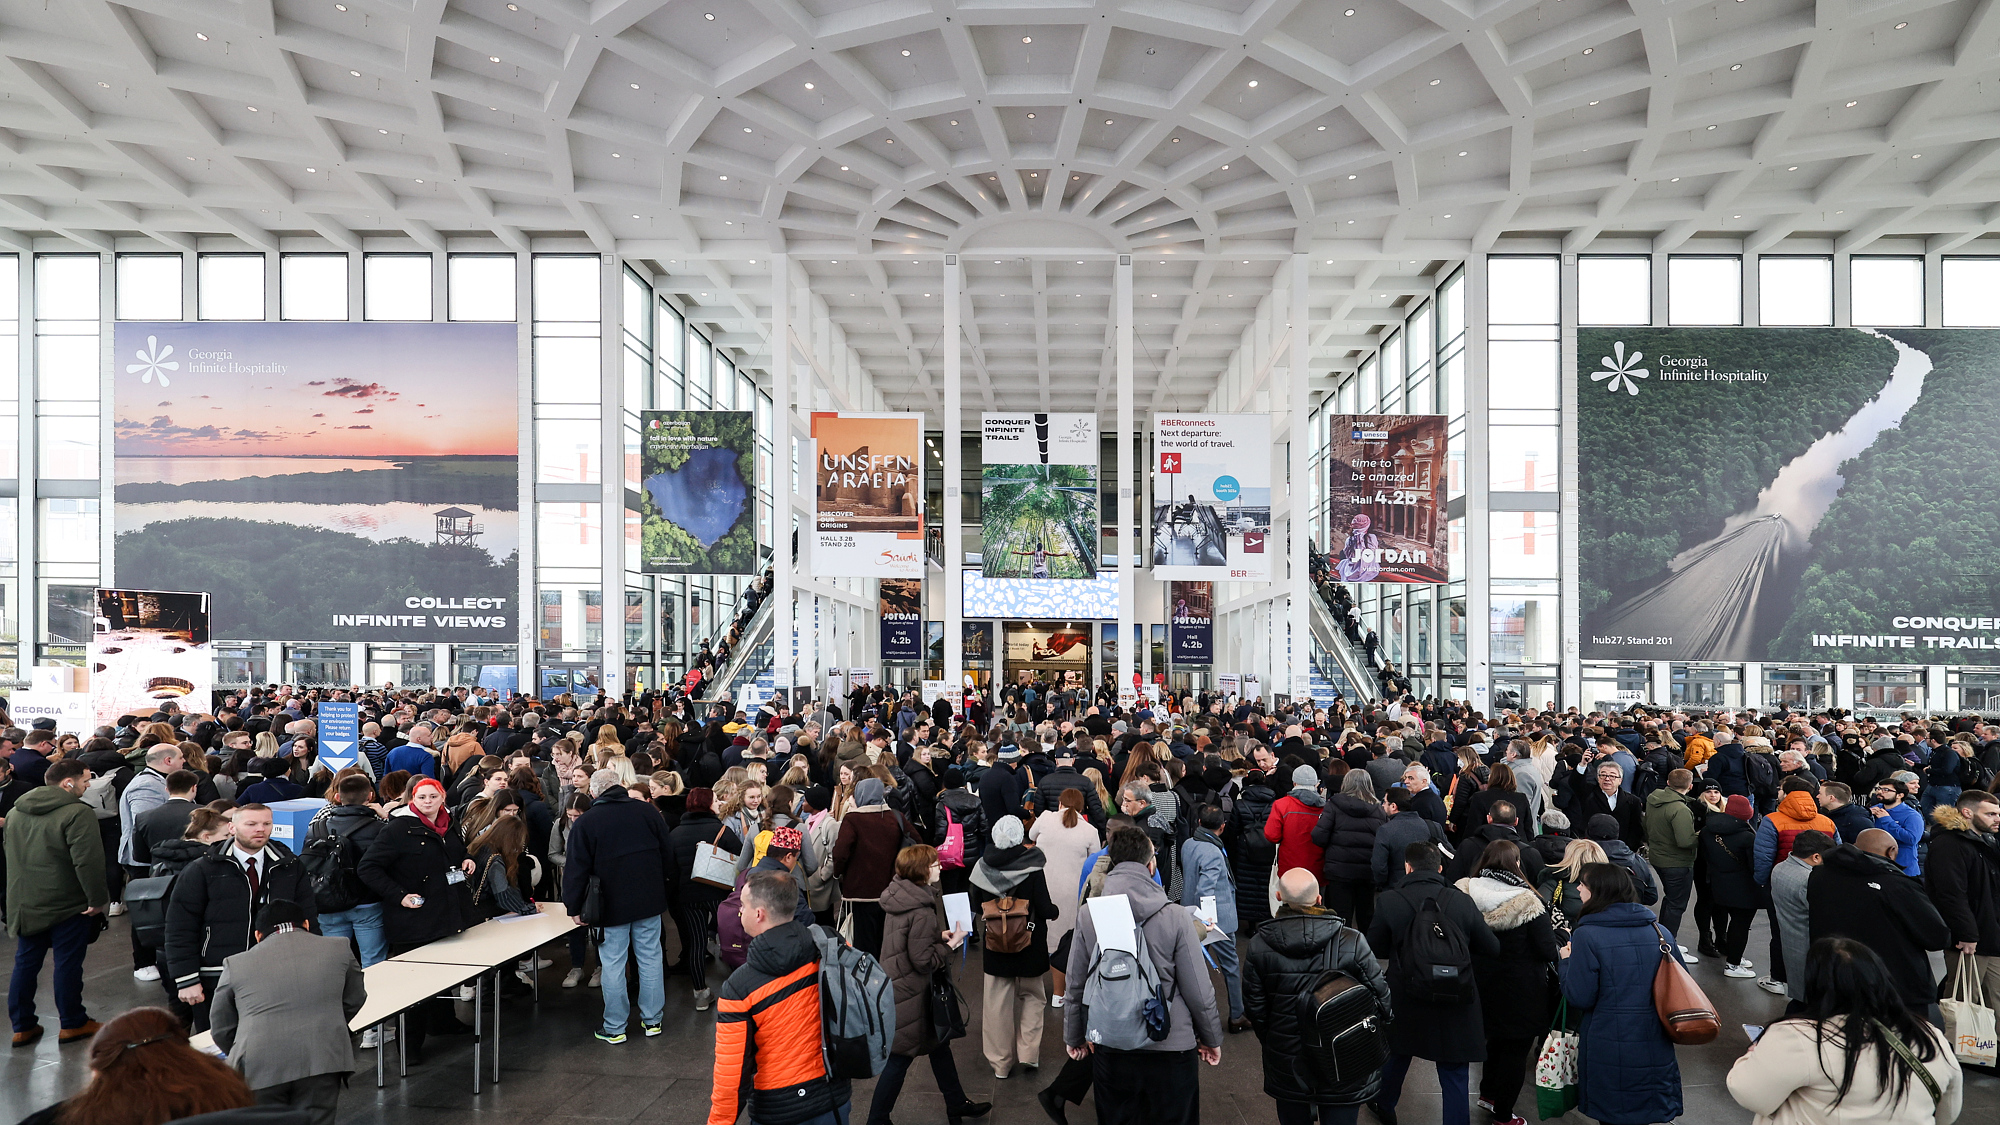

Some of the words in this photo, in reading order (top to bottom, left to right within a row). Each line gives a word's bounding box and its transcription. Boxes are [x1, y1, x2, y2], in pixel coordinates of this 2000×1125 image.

[188, 348, 233, 362] Georgia
[1659, 354, 1709, 369] Georgia
[188, 362, 227, 373] Infinite
[229, 362, 287, 376] Hospitality
[1659, 369, 1702, 381] Infinite
[1704, 369, 1769, 384] Hospitality
[1160, 419, 1216, 427] #BERconnects
[1180, 430, 1222, 438] departure:
[1160, 440, 1174, 448] the
[1175, 440, 1198, 448] world
[1199, 440, 1208, 448] of
[1210, 440, 1235, 448] travel.
[823, 454, 911, 471] UNSEEN
[1351, 458, 1377, 468] time
[1380, 459, 1392, 468] to
[826, 471, 906, 488] ARABIA
[1351, 472, 1366, 481] be
[1368, 472, 1415, 481] amazed
[1351, 495, 1372, 505] Hall
[1374, 490, 1417, 505] 4.2b
[1230, 569, 1247, 578] BER
[405, 596, 507, 610] COLLECT
[332, 614, 427, 627] INFINITE
[432, 615, 507, 628] VIEWS
[890, 636, 911, 645] 4.2b
[1181, 640, 1203, 649] 4.2b
[1592, 635, 1625, 645] hub27,
[1626, 636, 1654, 645] Stand
[1655, 637, 1673, 645] 201
[1812, 634, 1915, 648] INFINITE
[14, 706, 63, 715] GEORGIA
